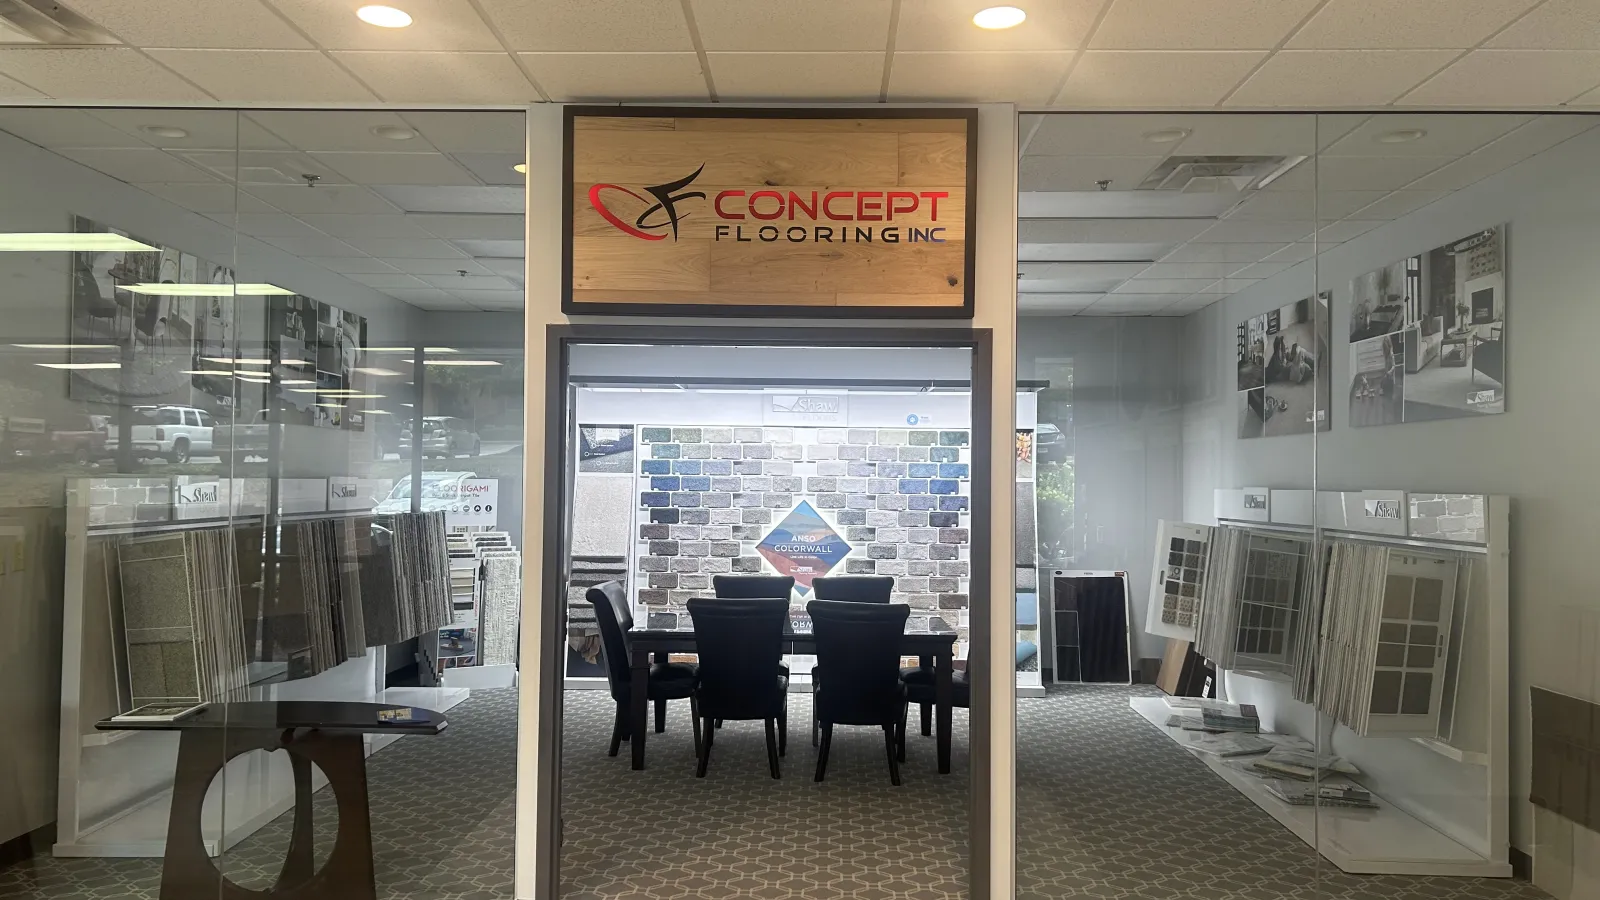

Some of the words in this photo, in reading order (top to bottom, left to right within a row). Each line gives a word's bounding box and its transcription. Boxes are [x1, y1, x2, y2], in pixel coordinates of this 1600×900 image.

[714, 190, 949, 221] CONCEPT
[715, 225, 900, 243] FLOORING
[908, 227, 947, 243] INC
[798, 398, 836, 412] Shaw
[1377, 502, 1399, 519] Shaw
[774, 544, 833, 553] COLORWALL
